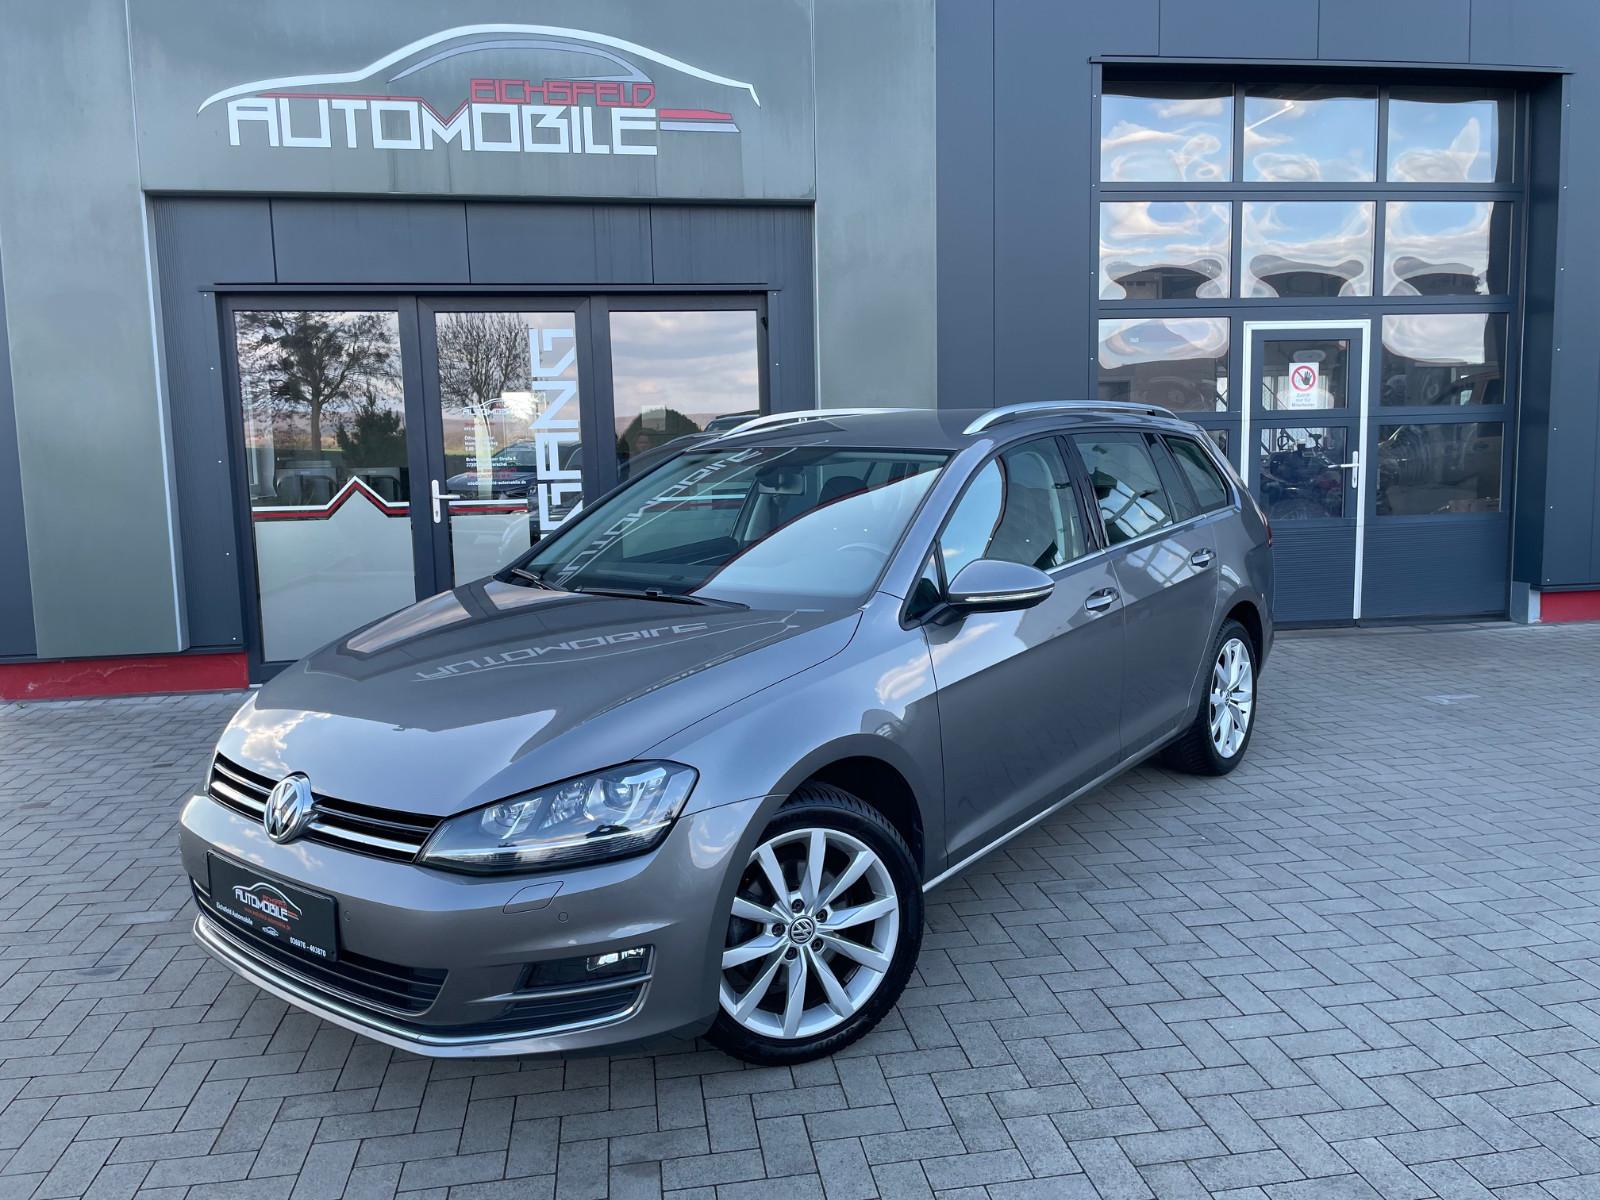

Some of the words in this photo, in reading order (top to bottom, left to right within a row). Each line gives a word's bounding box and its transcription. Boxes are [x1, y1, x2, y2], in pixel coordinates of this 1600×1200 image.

[470, 79, 655, 107] EICHSFELD
[227, 98, 657, 155] AUTOMOBILE
[528, 328, 583, 540] GANG
